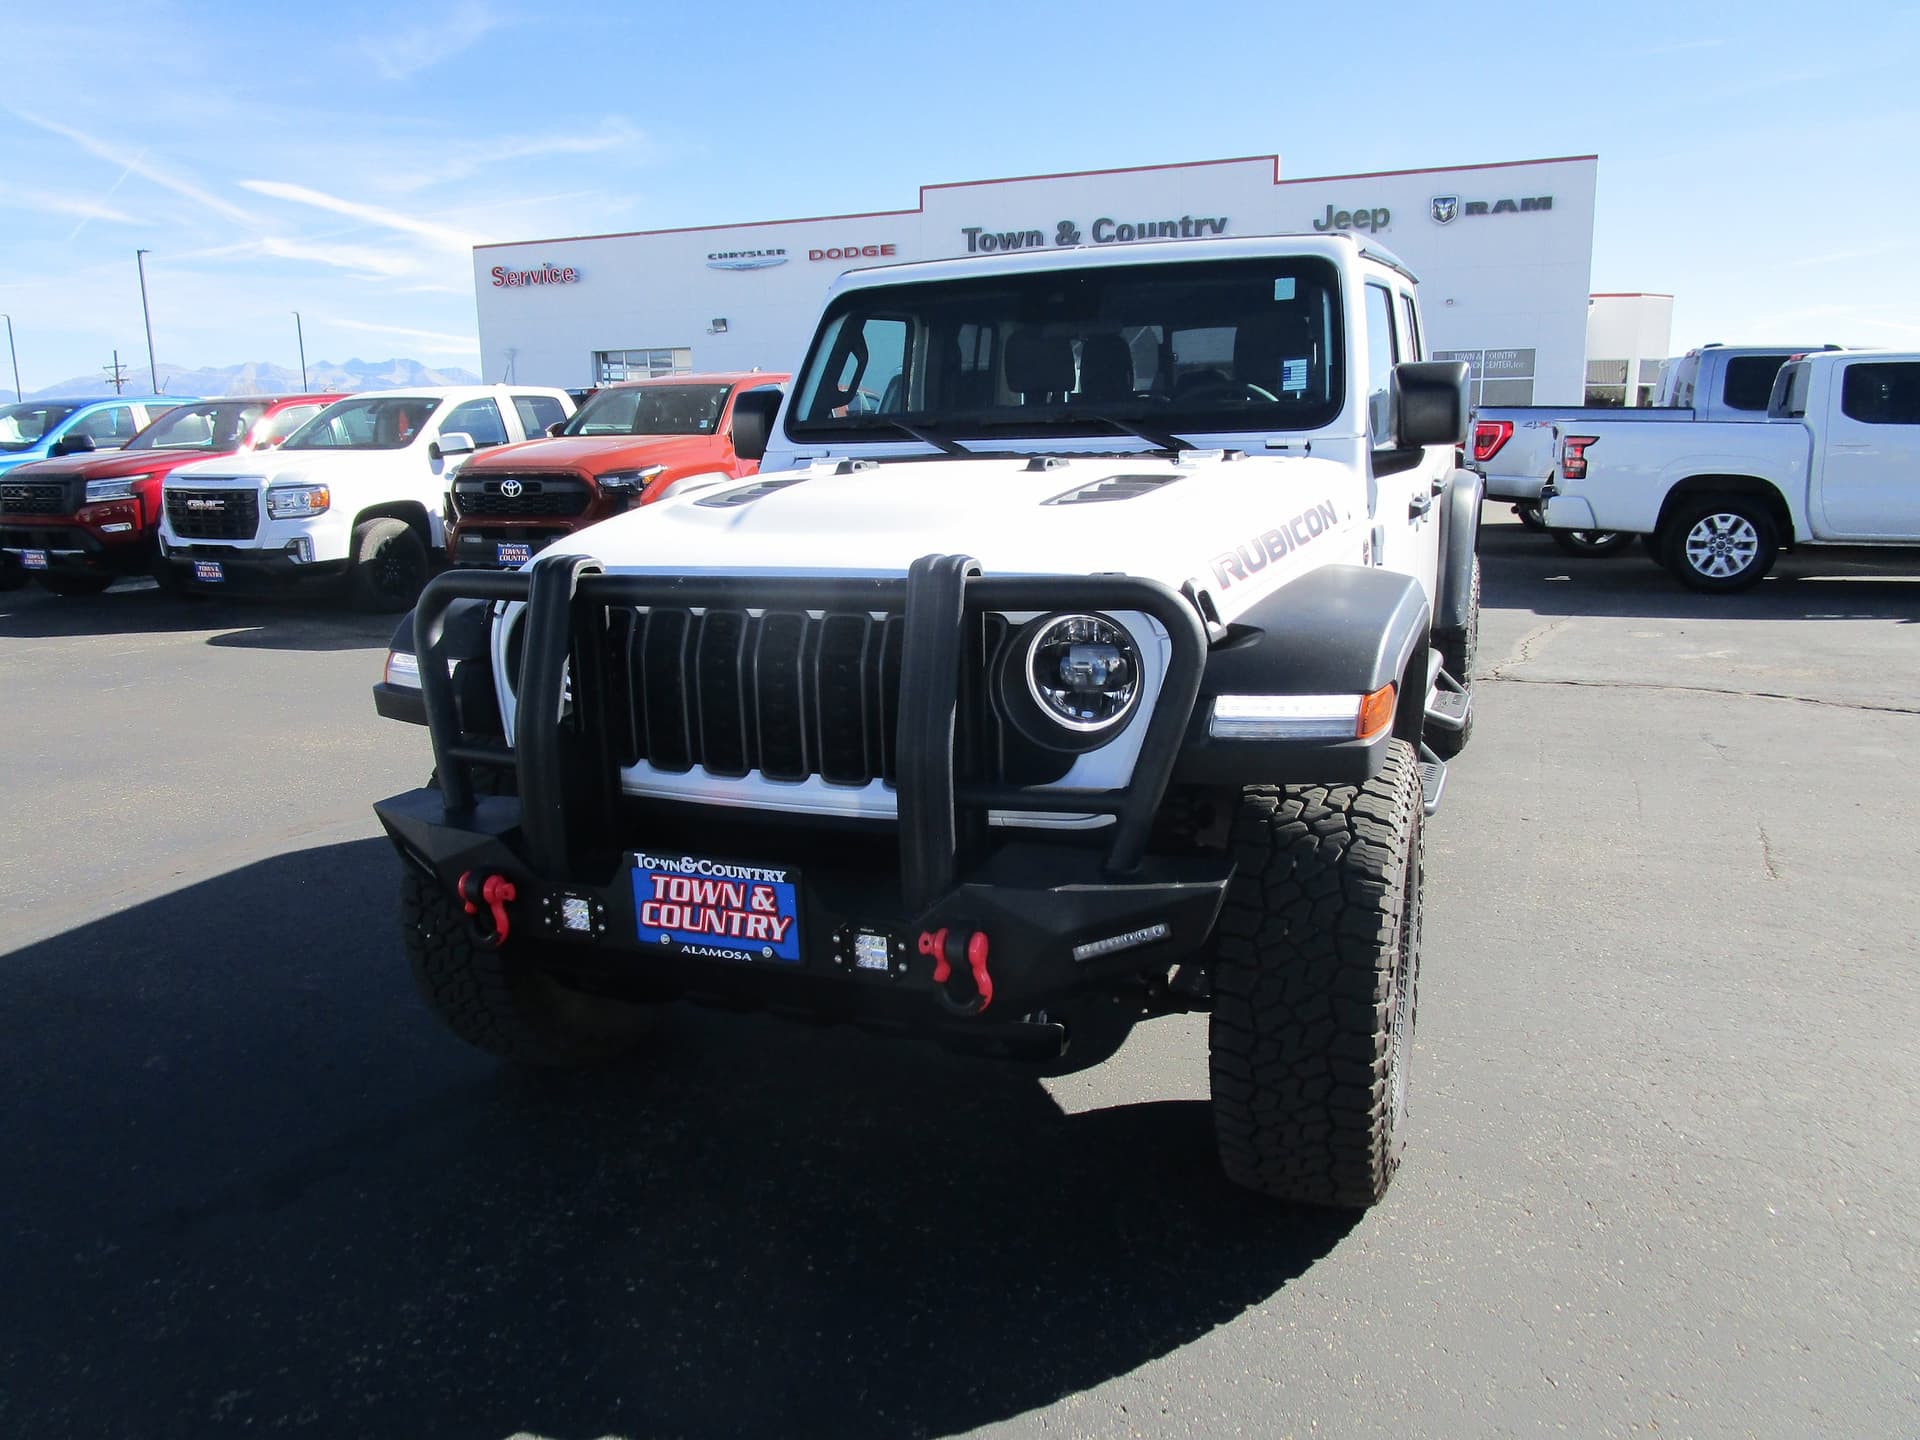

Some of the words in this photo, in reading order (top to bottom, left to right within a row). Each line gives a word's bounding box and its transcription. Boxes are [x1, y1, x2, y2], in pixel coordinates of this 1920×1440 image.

[1313, 204, 1390, 233] Jeep
[1465, 196, 1553, 216] RAM
[961, 227, 1044, 252] Town
[1055, 220, 1081, 246] &
[1092, 215, 1228, 243] Country
[707, 248, 786, 260] CHRYSLER
[808, 244, 897, 261] DODGE
[491, 262, 576, 287] Service
[186, 499, 225, 511] GMC
[1208, 499, 1338, 591] RUBICON
[651, 874, 745, 909] TOWN
[751, 886, 777, 913] &
[641, 902, 792, 942] COUNTRY
[681, 944, 753, 962] ALAMOSA
